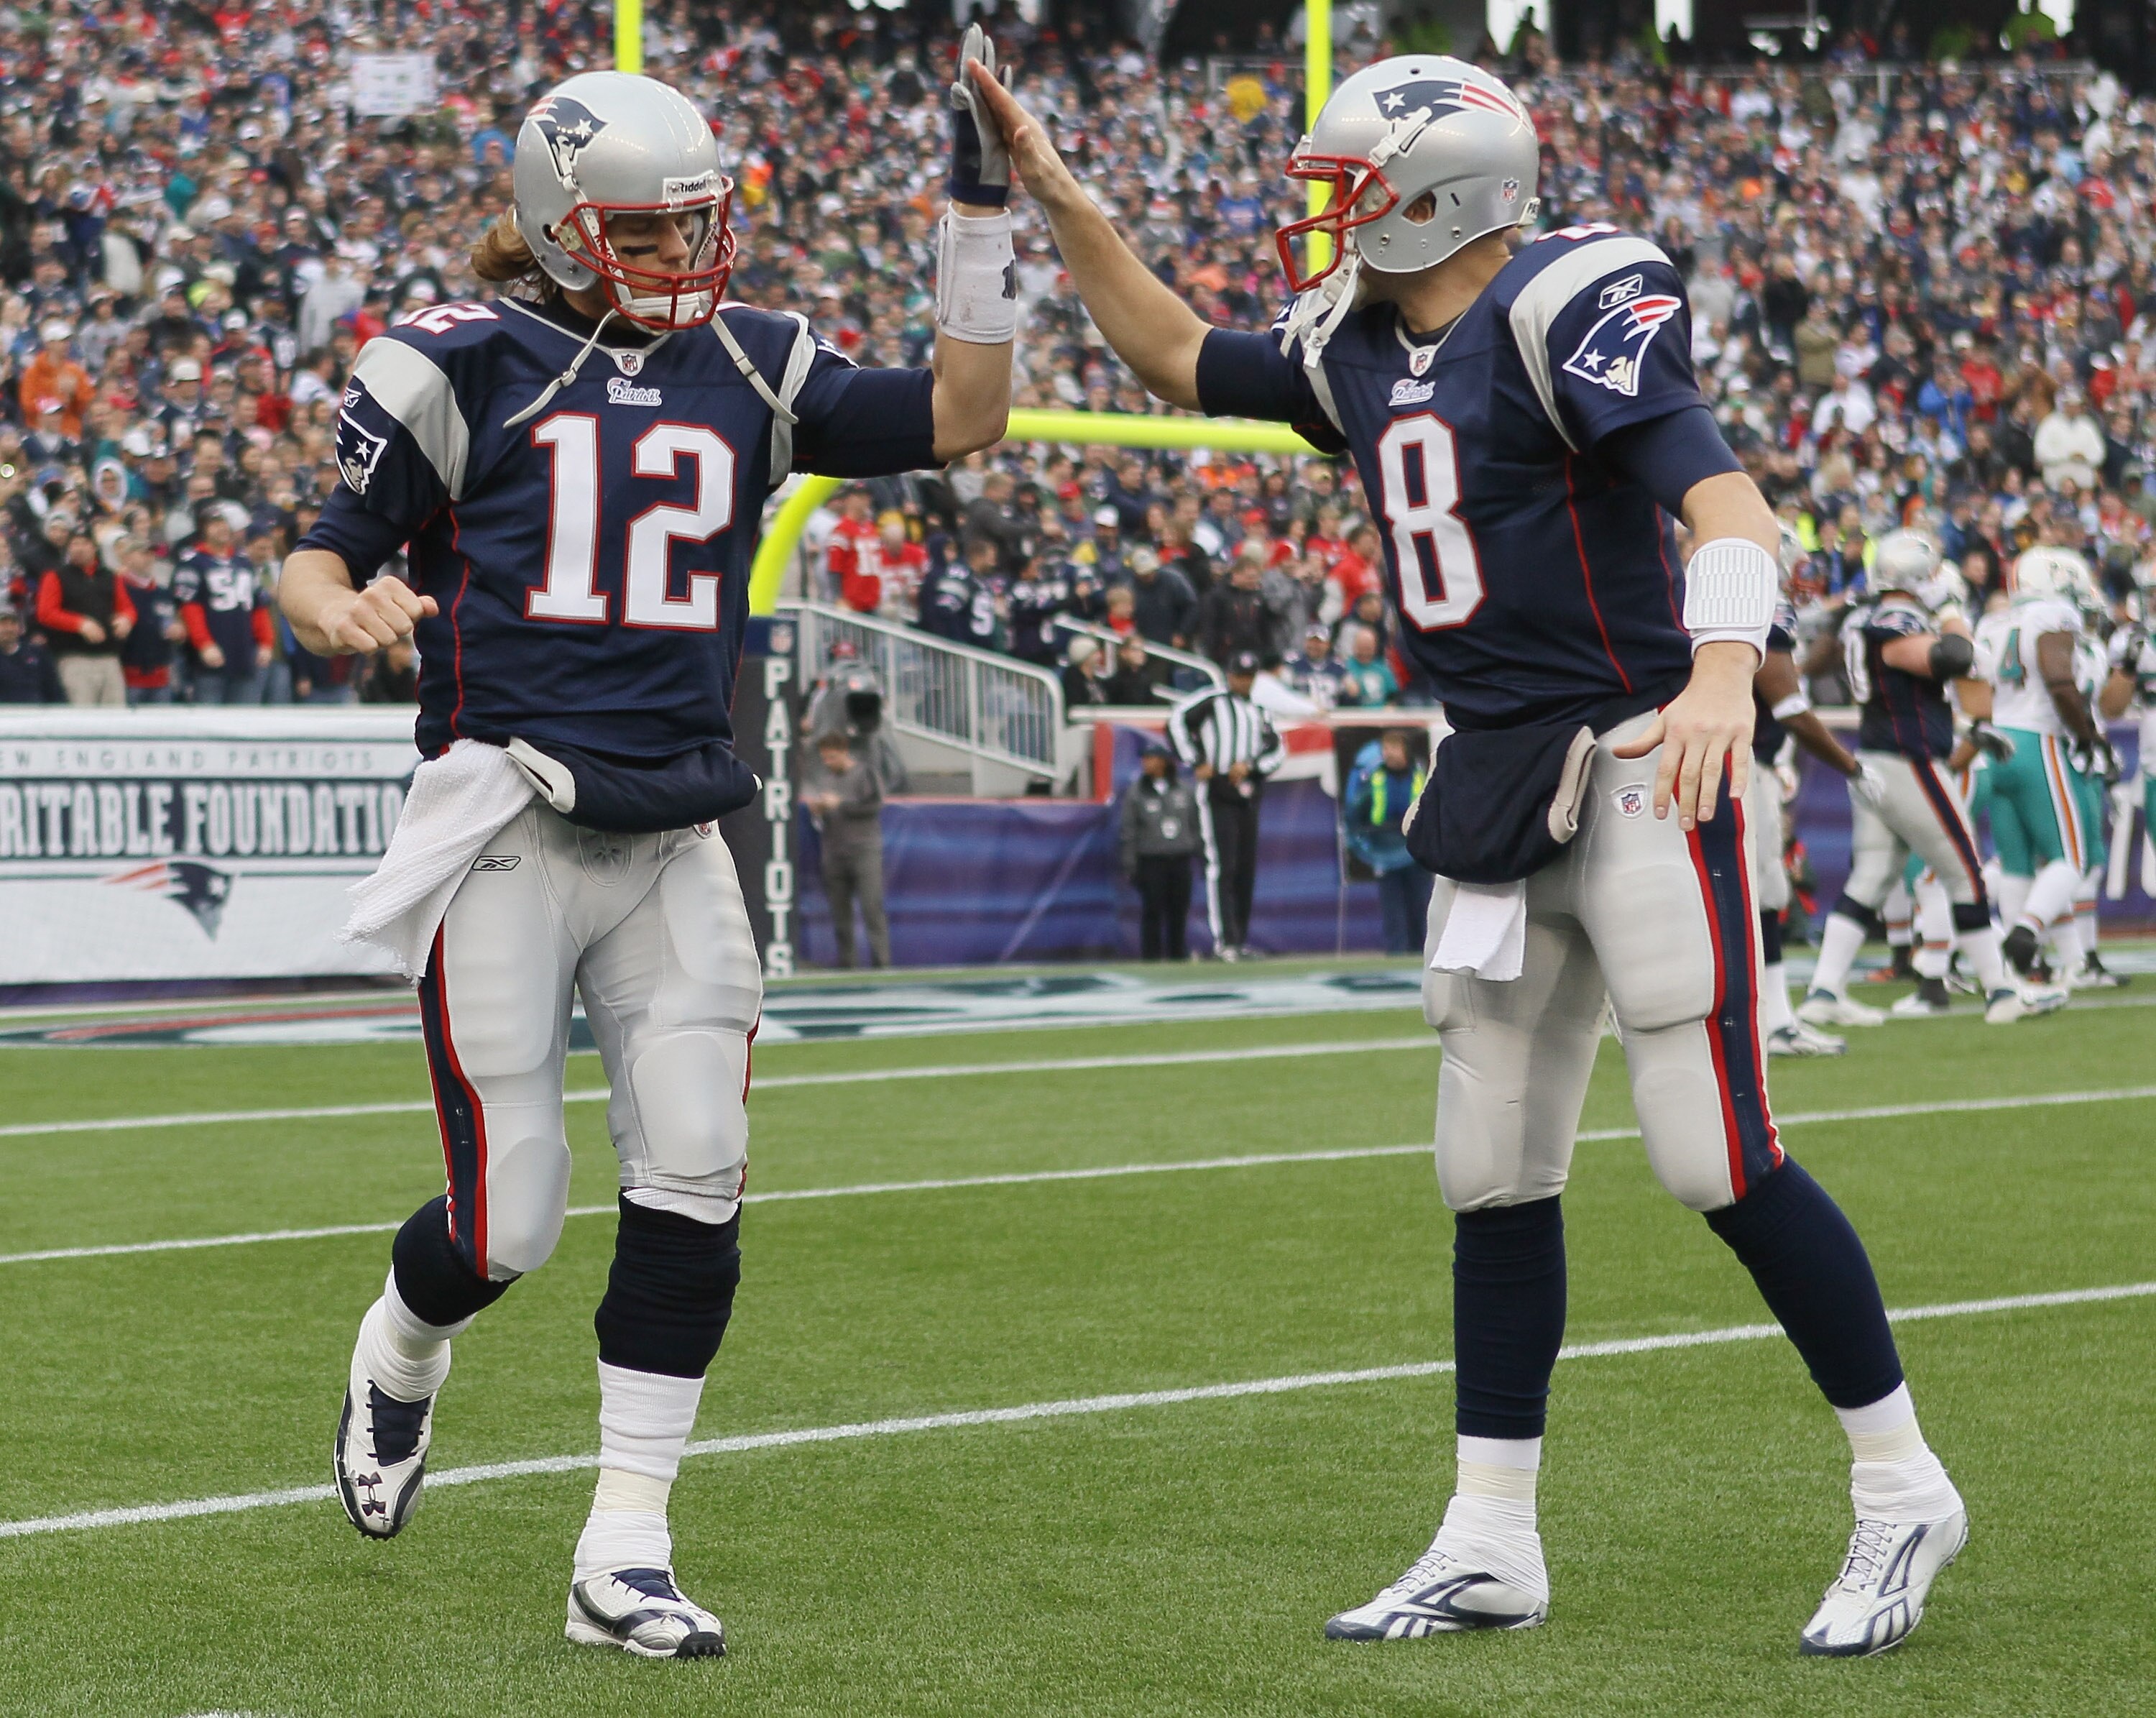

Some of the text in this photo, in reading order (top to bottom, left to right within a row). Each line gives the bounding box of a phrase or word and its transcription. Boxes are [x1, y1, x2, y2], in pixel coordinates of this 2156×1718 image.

[607, 384, 662, 406] Patriots
[524, 411, 737, 632] 12
[1376, 410, 1487, 633] 8
[57, 750, 205, 769] ENGLAND
[229, 750, 372, 770] PATRIOTS
[764, 658, 793, 978] PATRIOTS
